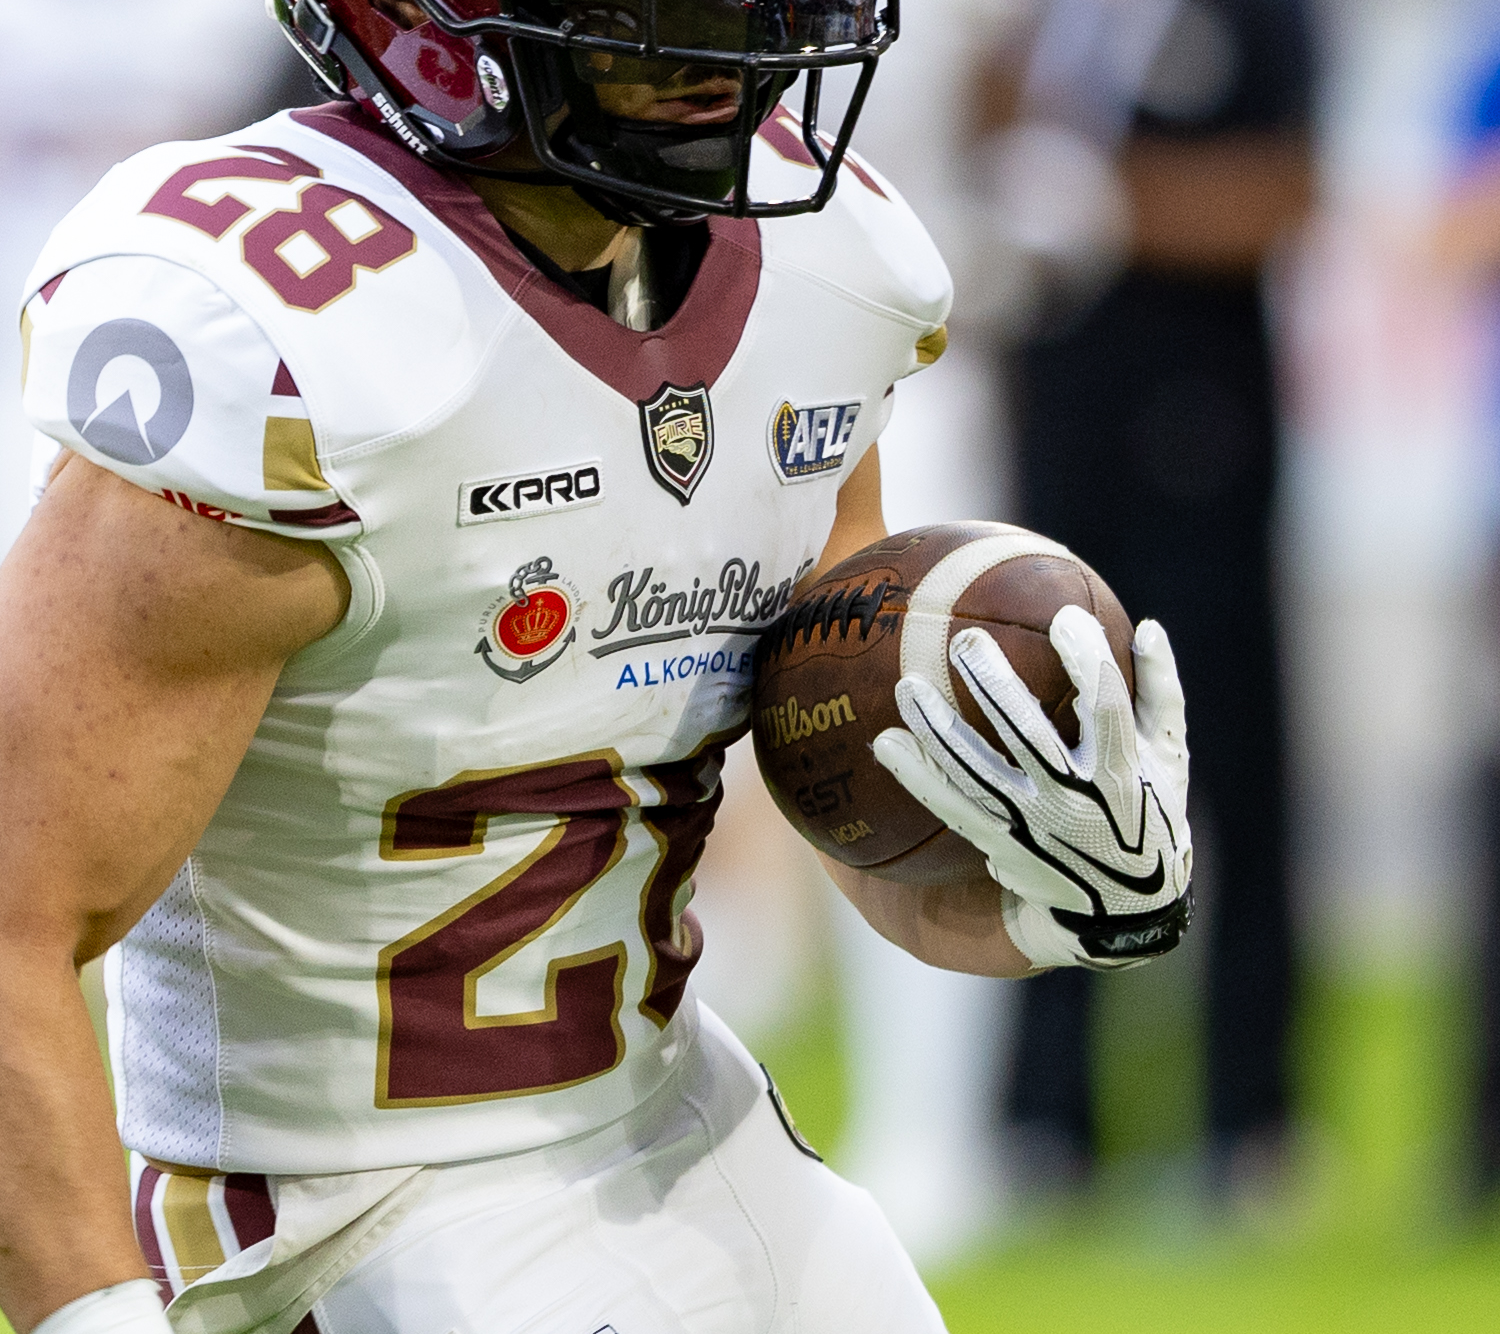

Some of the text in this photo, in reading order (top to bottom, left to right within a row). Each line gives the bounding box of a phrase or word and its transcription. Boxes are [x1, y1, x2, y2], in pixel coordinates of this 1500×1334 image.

[137, 145, 418, 315] 28
[653, 413, 705, 453] FIRE
[786, 405, 860, 464] AFLE
[478, 596, 505, 633] PURUM
[761, 693, 857, 749] Wilson
[829, 819, 875, 846] NCAA
